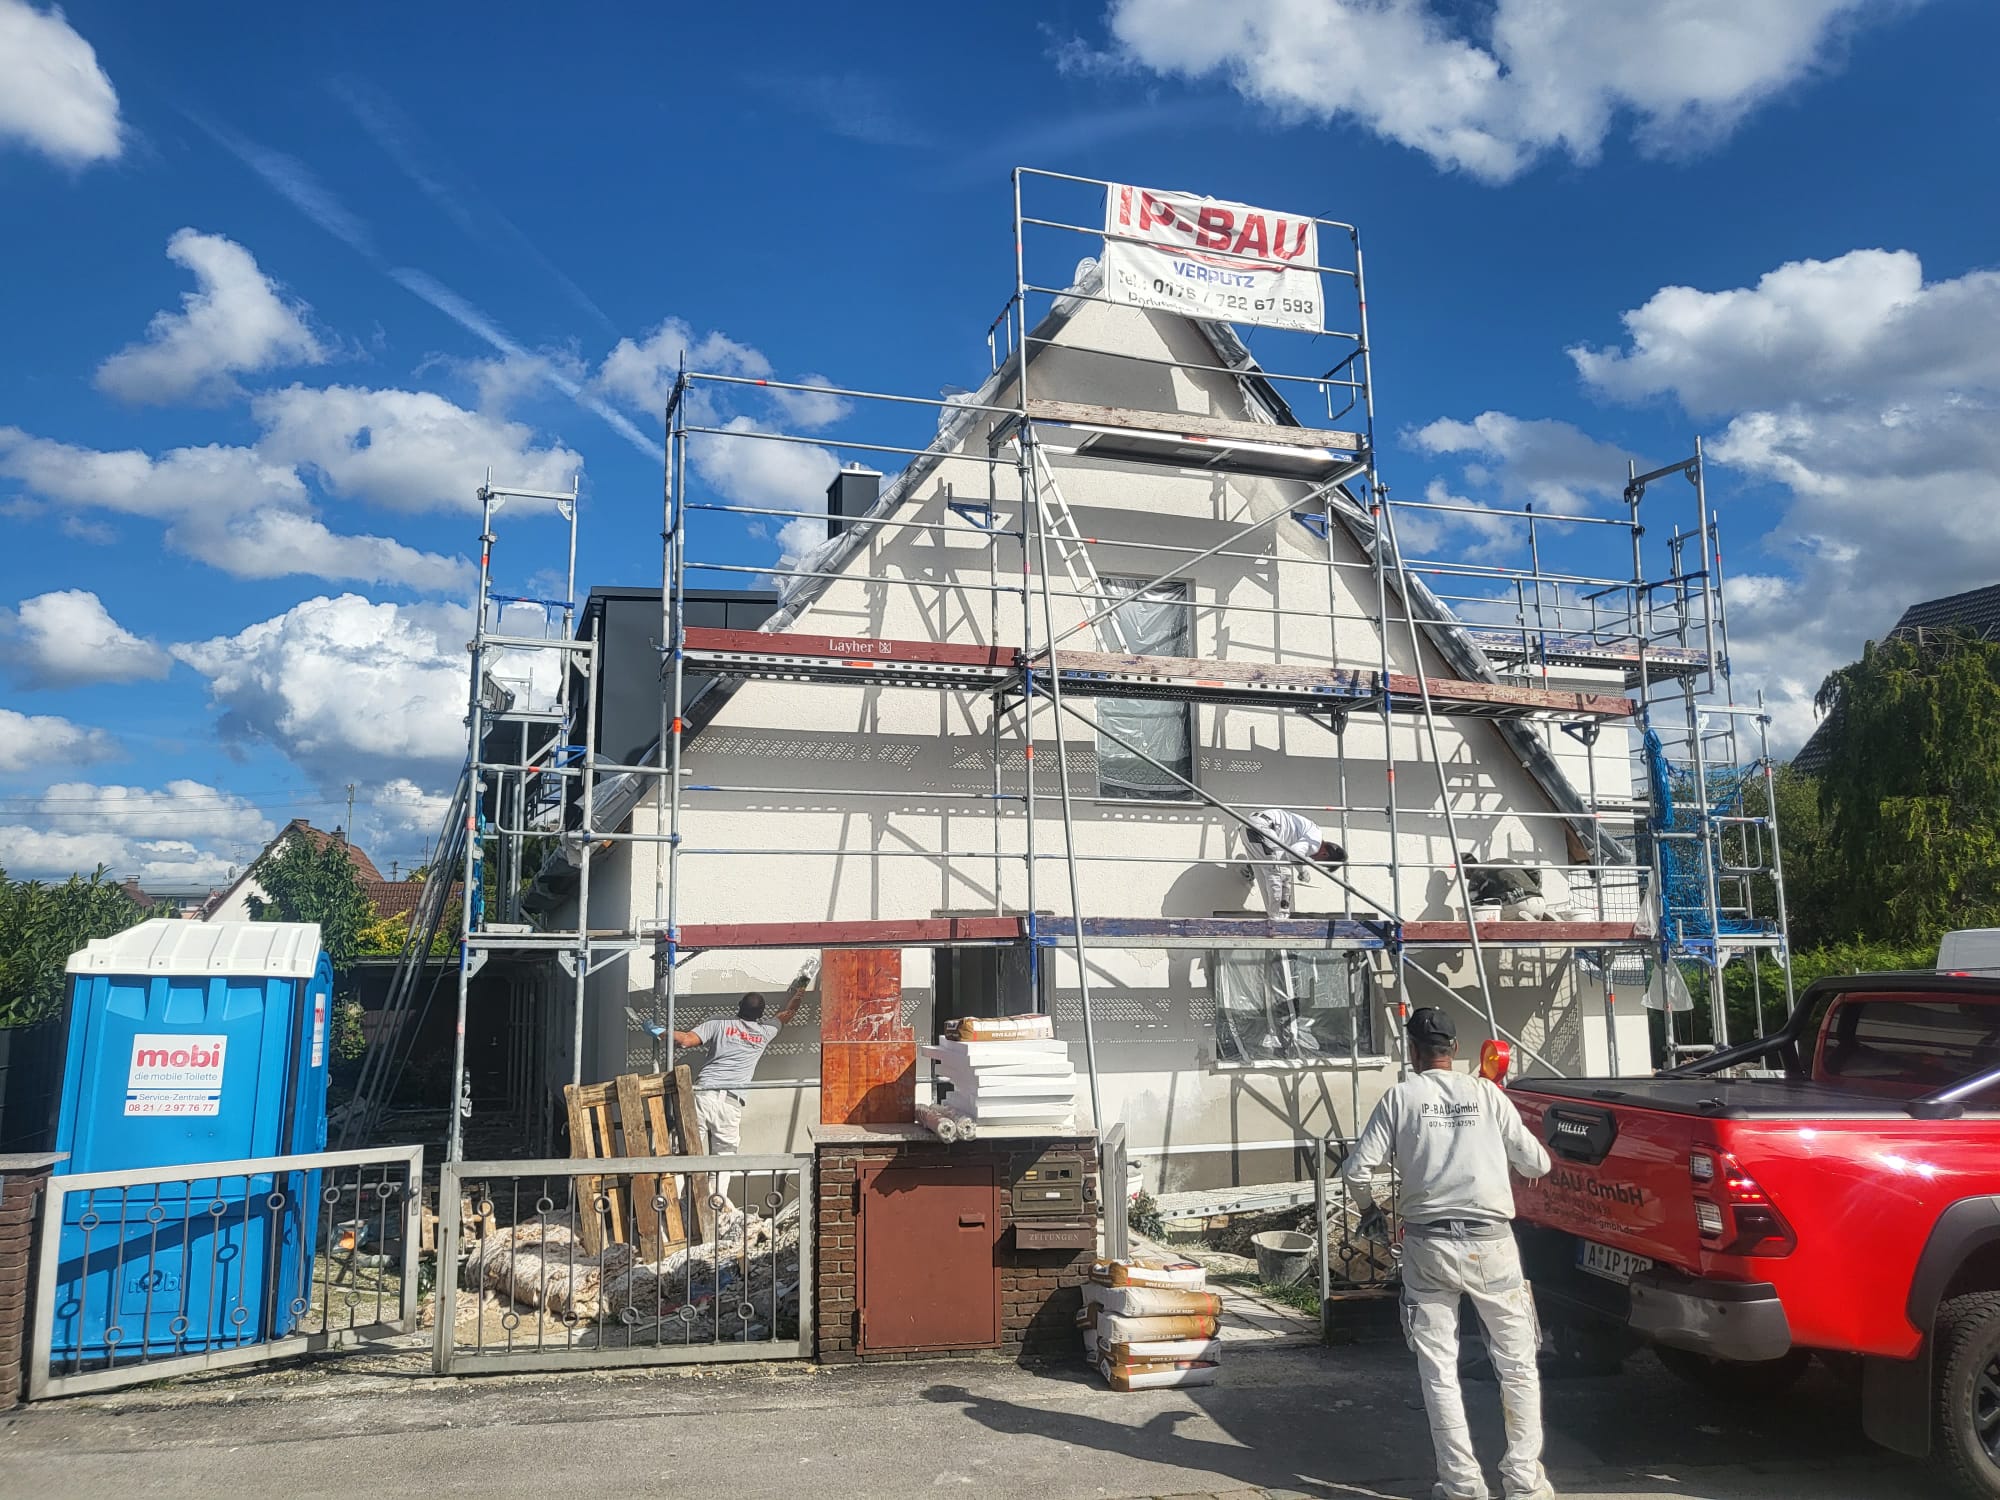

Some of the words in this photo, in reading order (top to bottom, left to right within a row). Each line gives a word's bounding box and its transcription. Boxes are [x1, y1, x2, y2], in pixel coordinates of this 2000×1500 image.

[1118, 185, 1309, 261] IP-BAU
[1173, 260, 1255, 289] VERPUTZ
[1215, 292, 1248, 311] 722
[1254, 297, 1276, 311] 67
[1282, 297, 1314, 315] 593
[829, 639, 874, 654] Layher
[136, 1043, 221, 1068] mobi
[134, 1072, 149, 1081] die
[150, 1072, 183, 1081] mobile
[184, 1072, 218, 1081] Toilette
[139, 1093, 207, 1102] Service-Zentrale
[128, 1103, 141, 1112] 08
[143, 1103, 154, 1112] 21
[188, 1103, 200, 1112] 76
[202, 1103, 215, 1112] 77
[1557, 1121, 1590, 1137] HILUX
[1586, 1177, 1645, 1208] GmbH
[1028, 1233, 1079, 1241] ZEITUNGEN
[1588, 1244, 1597, 1266] A
